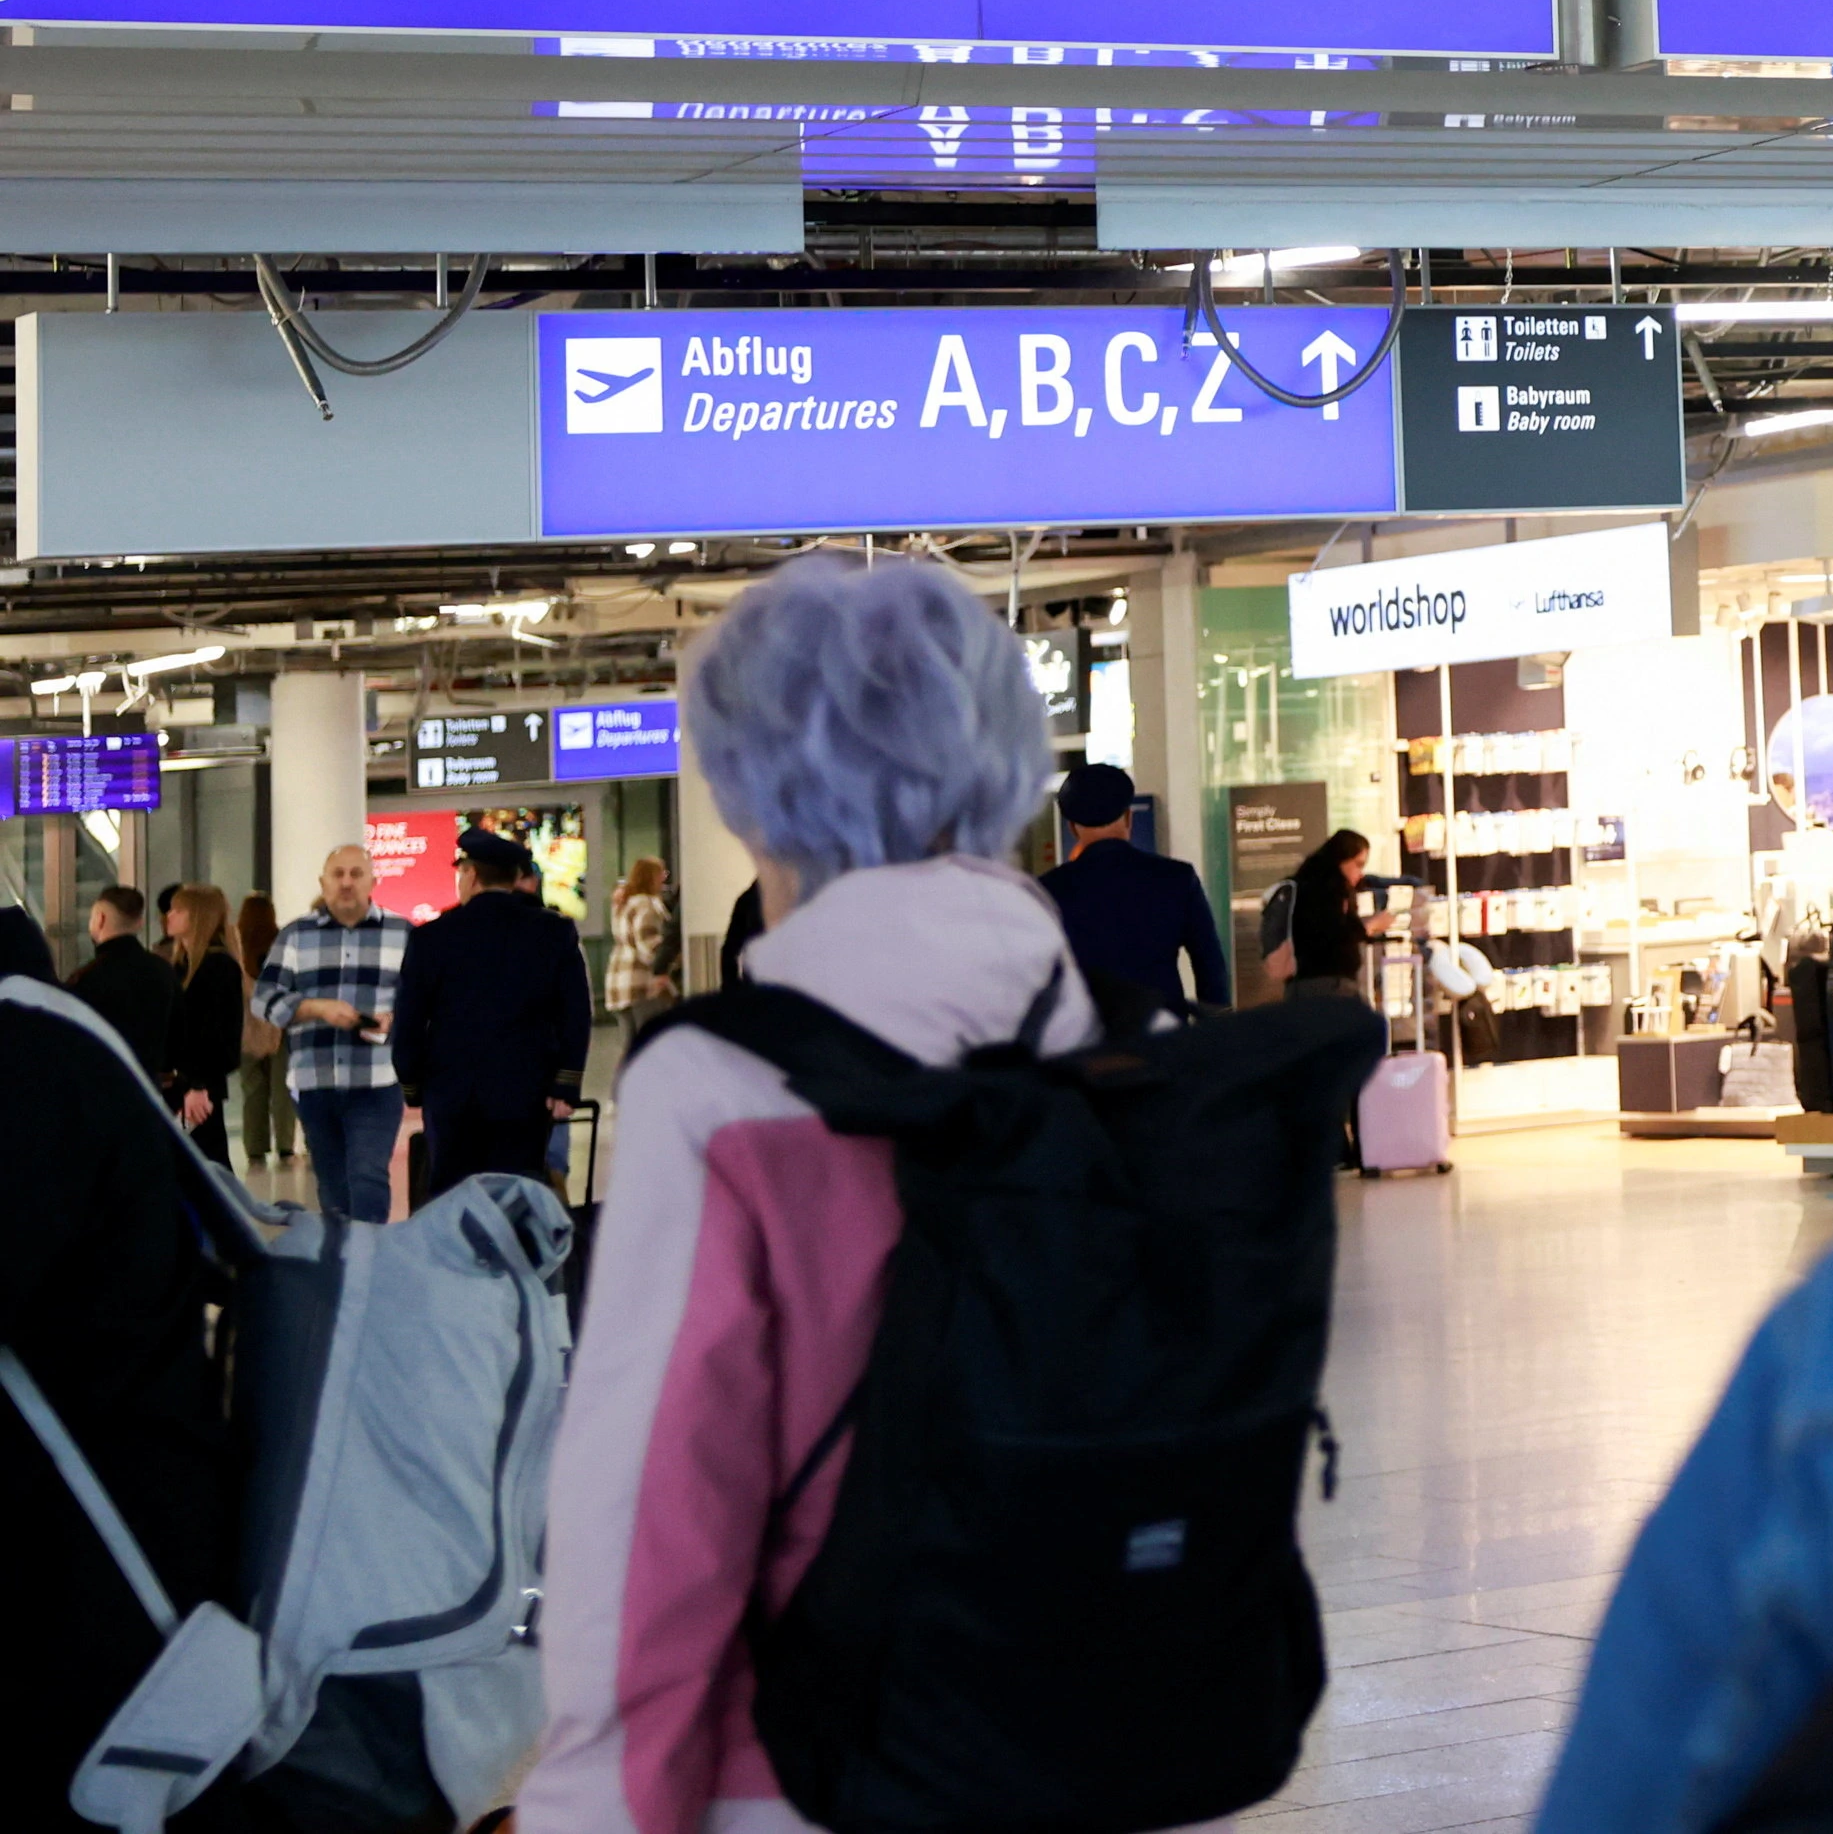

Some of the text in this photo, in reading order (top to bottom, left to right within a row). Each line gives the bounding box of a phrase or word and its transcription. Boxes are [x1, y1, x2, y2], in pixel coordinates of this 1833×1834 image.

[1505, 315, 1579, 339] Toiletten
[681, 336, 812, 382] Abflug
[1505, 340, 1561, 363] Toilets
[1507, 385, 1592, 411] Babyraum
[683, 392, 897, 440] Departures
[1507, 411, 1596, 436] Baby room
[1330, 584, 1605, 637] worldshop Lufthansa
[596, 709, 642, 730] Abflug
[596, 727, 670, 750] Departures
